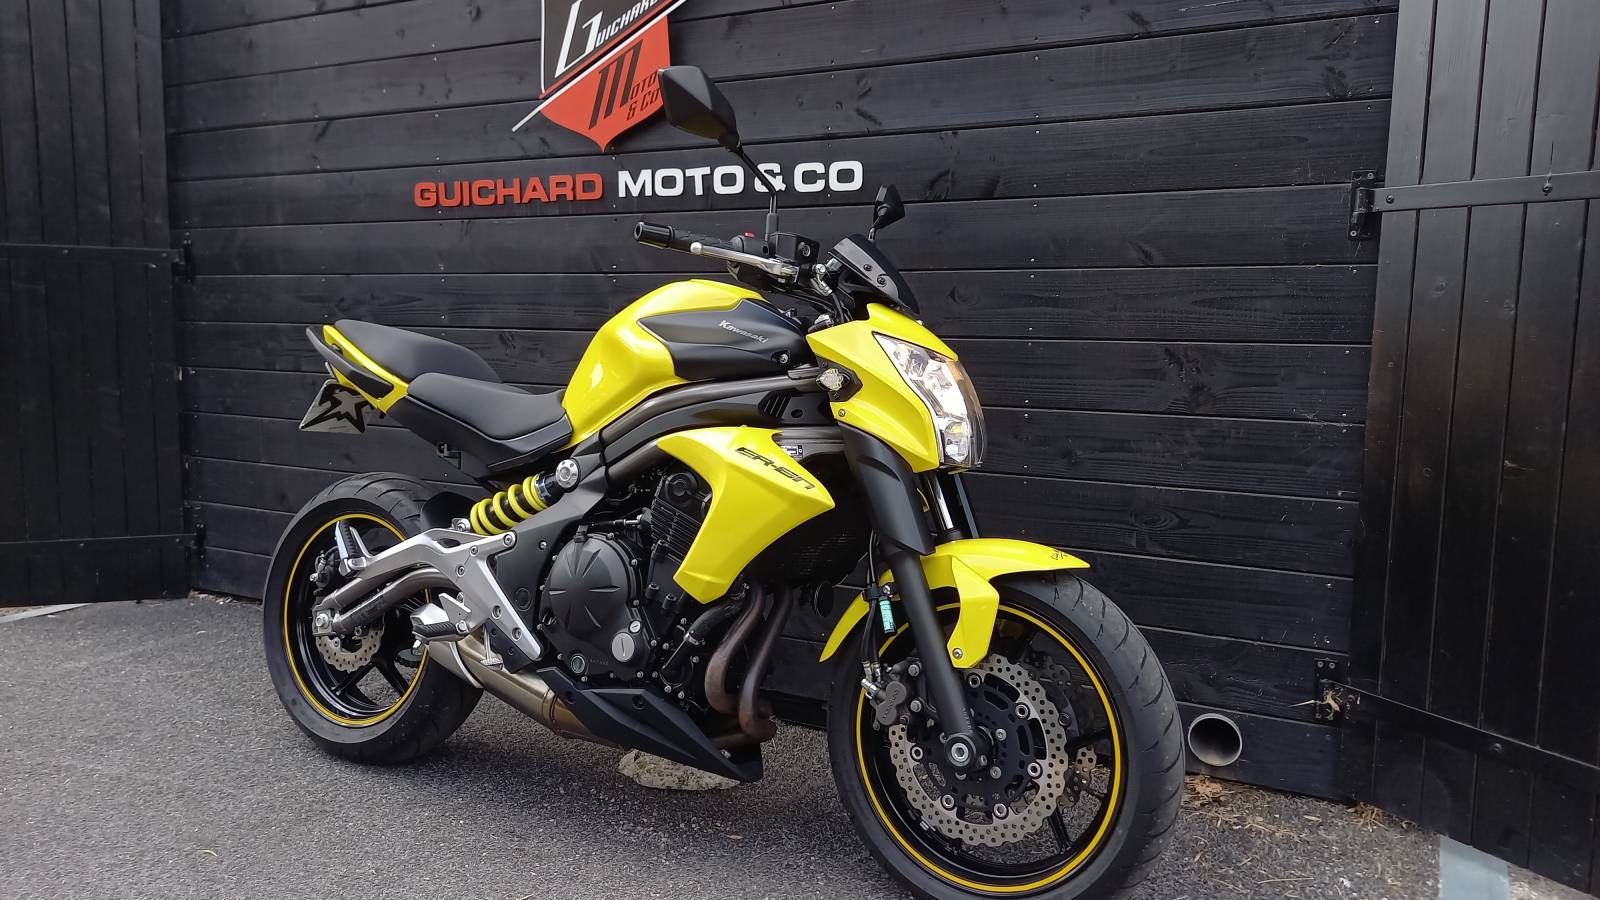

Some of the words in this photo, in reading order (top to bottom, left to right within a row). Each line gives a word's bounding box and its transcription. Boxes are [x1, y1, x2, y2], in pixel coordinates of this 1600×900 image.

[414, 173, 603, 207] GUICHARD
[618, 165, 745, 198] MOTO
[754, 162, 787, 193] &
[793, 160, 863, 193] CO
[719, 320, 769, 343] Kawasaki
